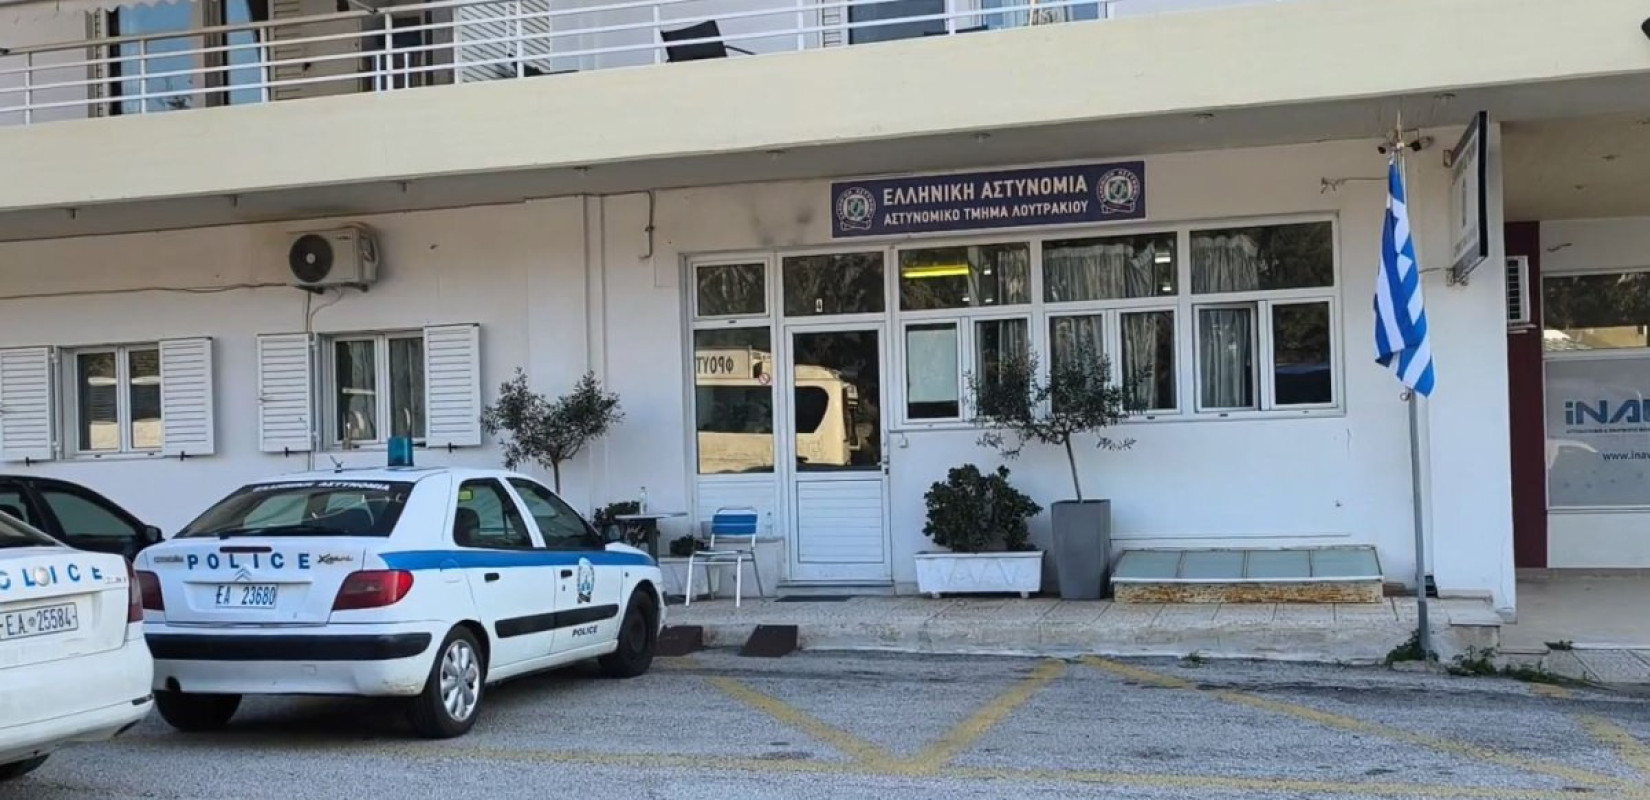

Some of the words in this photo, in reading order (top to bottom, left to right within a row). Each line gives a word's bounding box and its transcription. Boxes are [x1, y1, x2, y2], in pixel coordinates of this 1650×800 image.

[883, 182, 975, 206] ΕΛΛΗΝΙΚΗ
[981, 175, 1088, 199] ΑΣΤΥΝΟΜΙΑ
[884, 207, 960, 226] ΑΣΤΥΝΟΜΙΚΟ
[964, 204, 1009, 220] ΤΜΗΜΑ
[1011, 200, 1089, 217] ΛΟΥΤΡΑΚΙΟΥ
[187, 553, 310, 570] POLICE
[241, 586, 276, 605] 23680
[37, 607, 71, 632] 25584
[572, 625, 598, 637] POLICE
